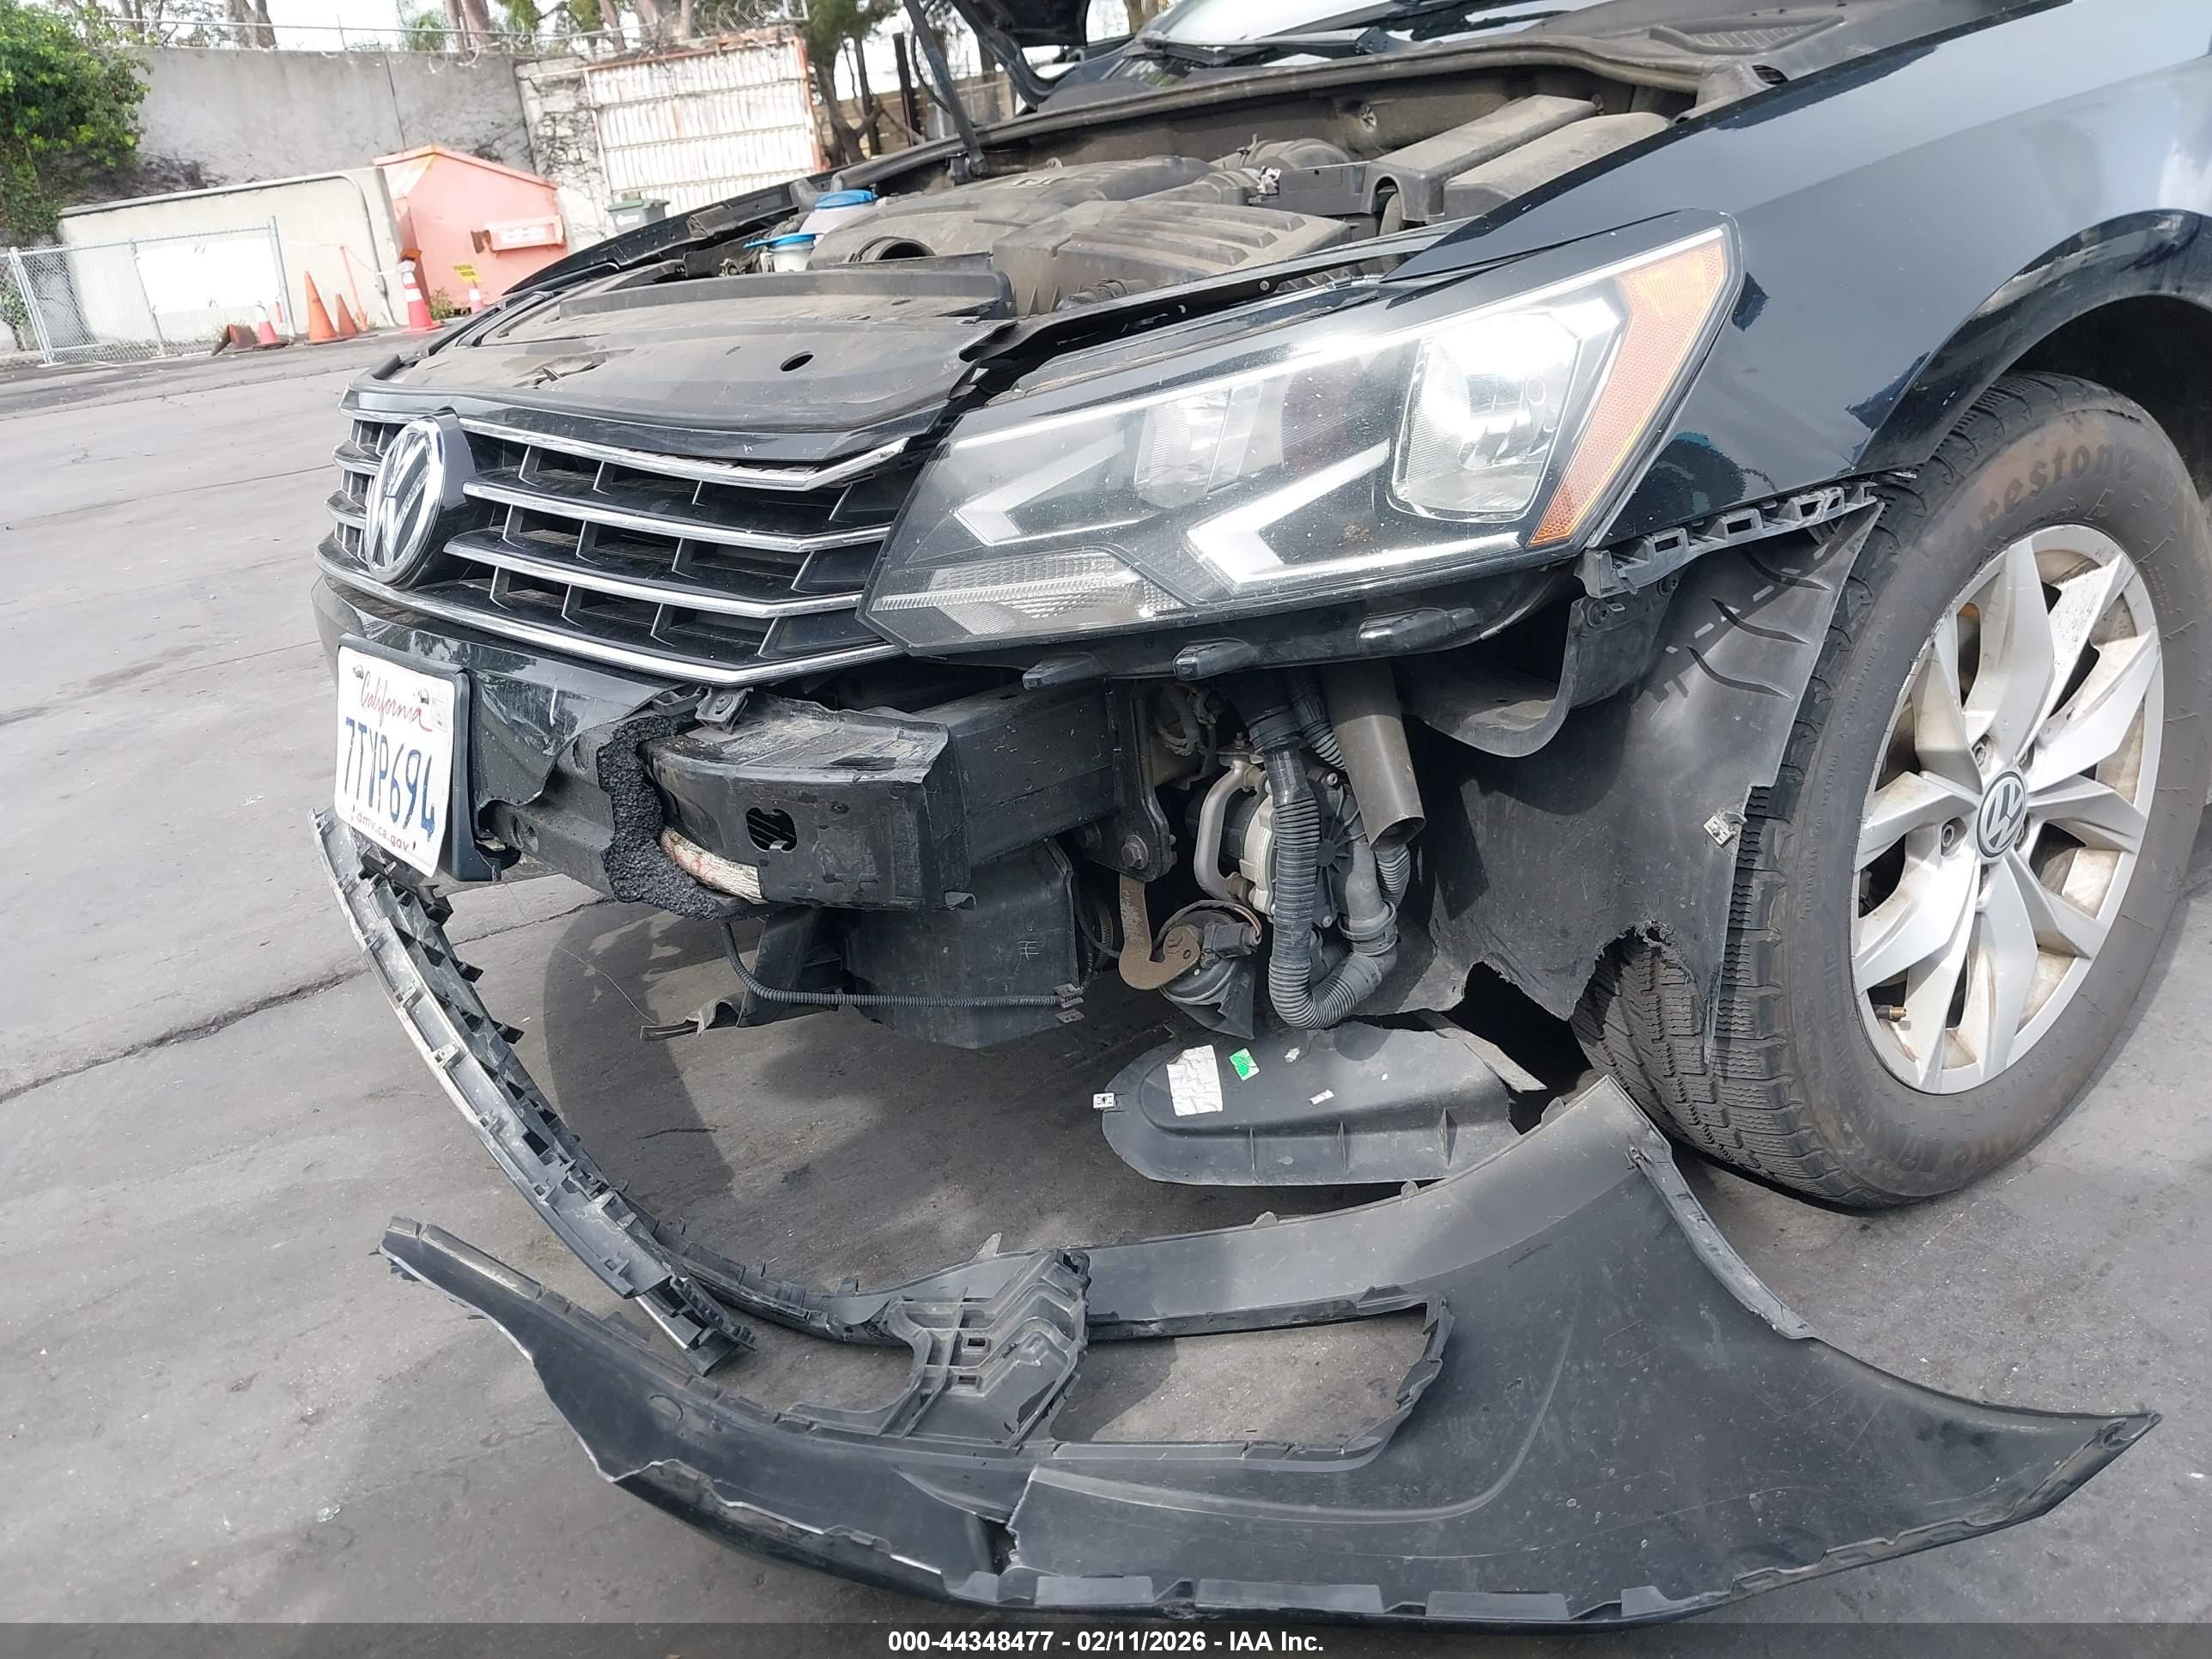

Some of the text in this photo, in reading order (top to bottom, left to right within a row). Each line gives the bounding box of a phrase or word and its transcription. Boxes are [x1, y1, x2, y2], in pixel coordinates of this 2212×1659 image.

[1964, 443, 2137, 539] restone
[361, 671, 433, 732] California
[344, 716, 435, 842] 7TYP694
[356, 810, 410, 852] dmv.ca.gov
